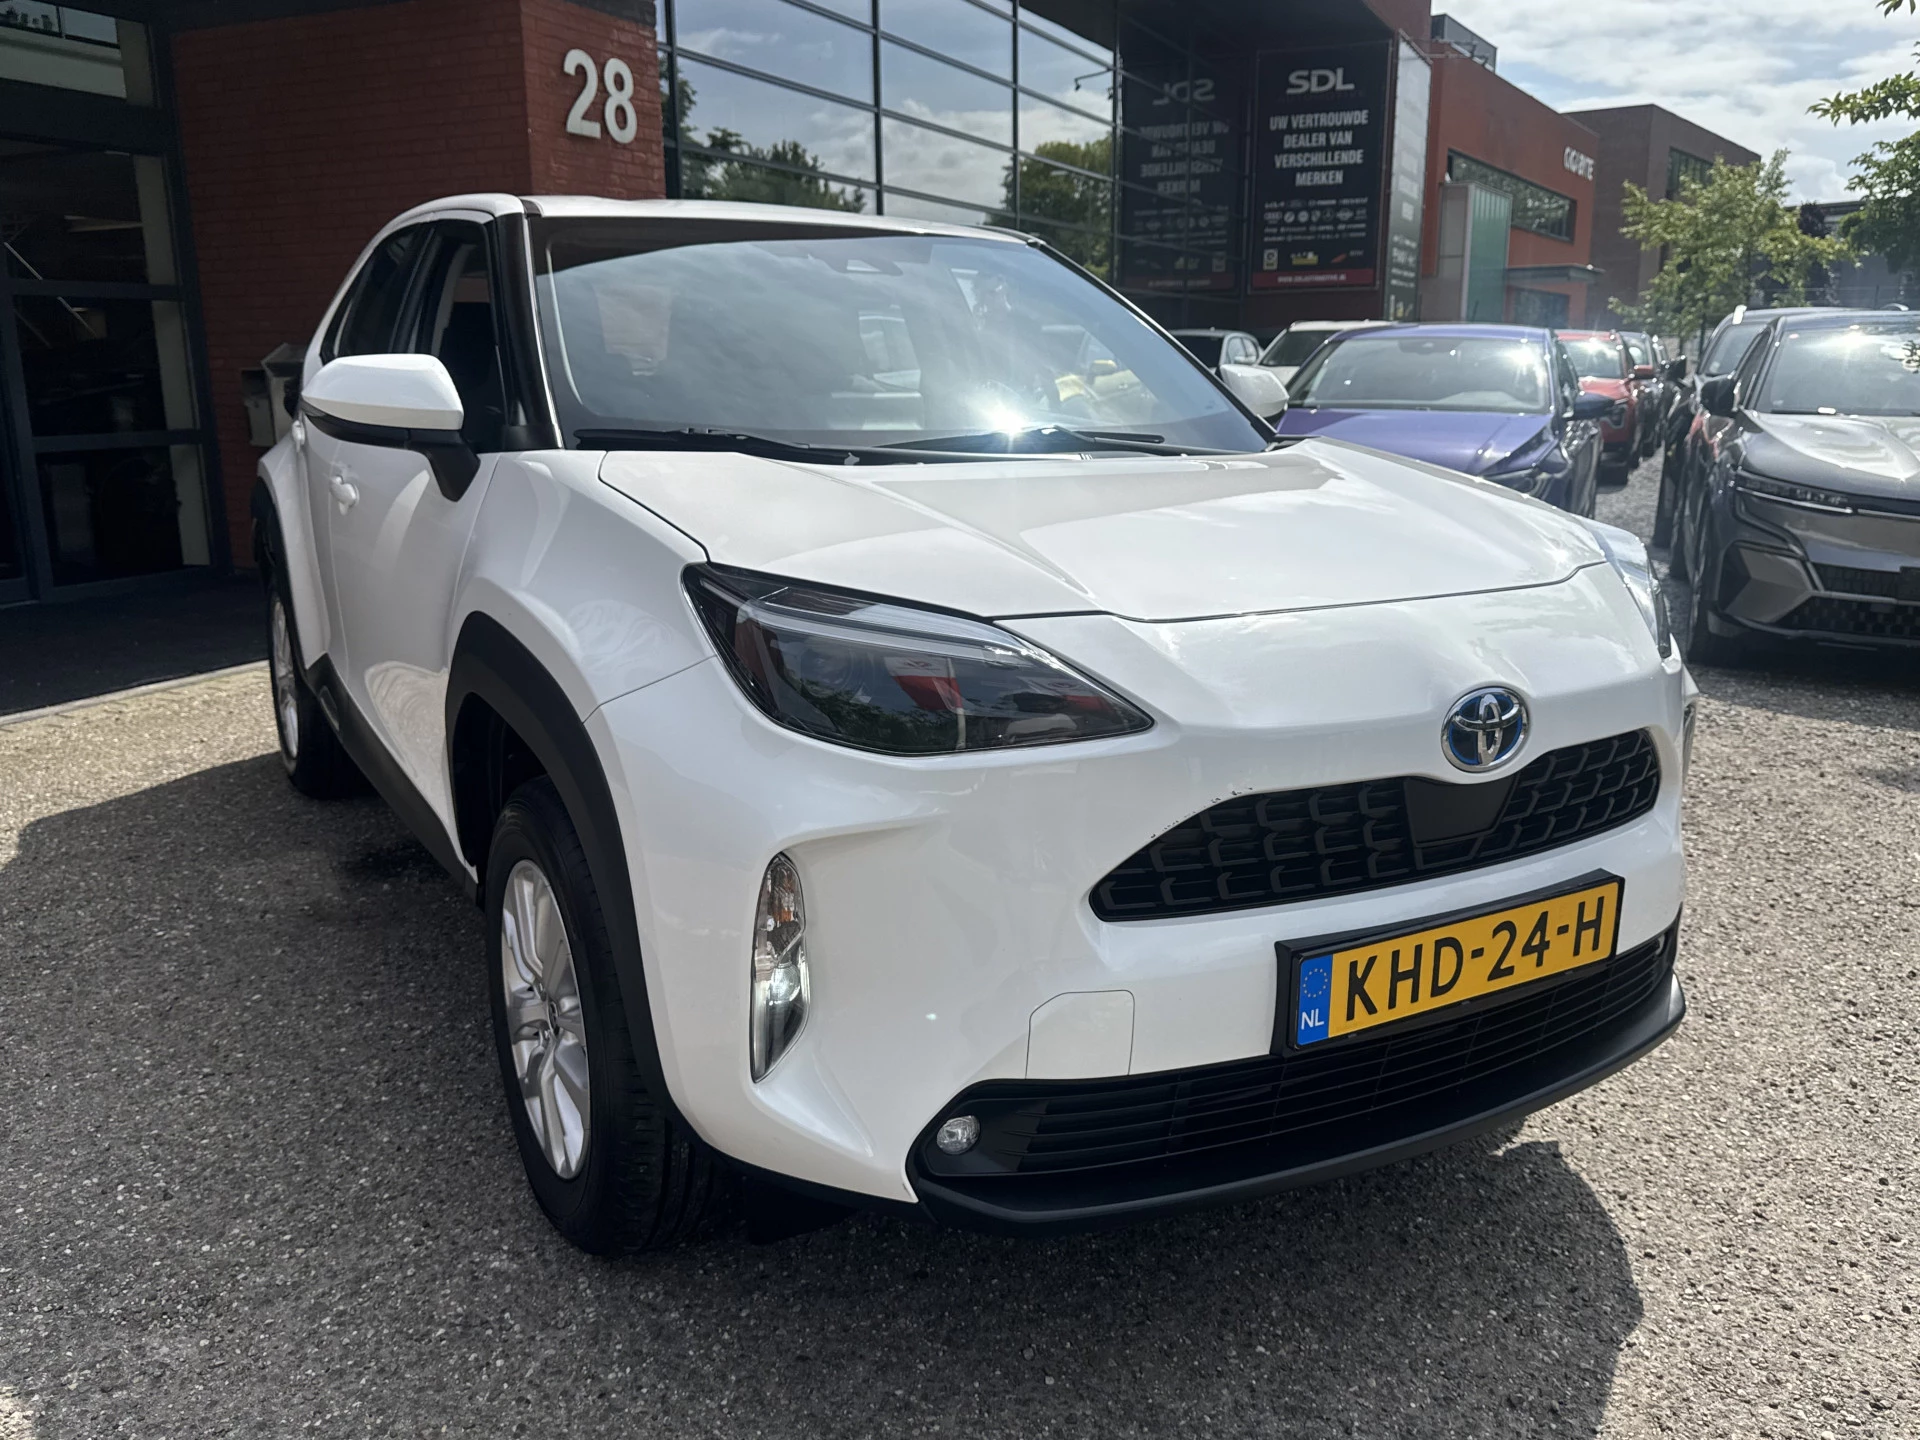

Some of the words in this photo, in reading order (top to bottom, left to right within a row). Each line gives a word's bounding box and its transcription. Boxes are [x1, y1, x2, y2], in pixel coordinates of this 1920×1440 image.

[1286, 67, 1355, 95] SDL
[564, 48, 637, 144] 28
[1270, 115, 1288, 131] UW
[1291, 110, 1369, 130] VERTROUWDE
[1283, 132, 1326, 149] DEALER
[1330, 130, 1353, 146] VAN
[1274, 149, 1364, 168] VERSCHILLENDE
[1295, 170, 1343, 187] MERKEN
[1346, 896, 1605, 1022] KHD-24-H
[1301, 1008, 1324, 1031] NL
